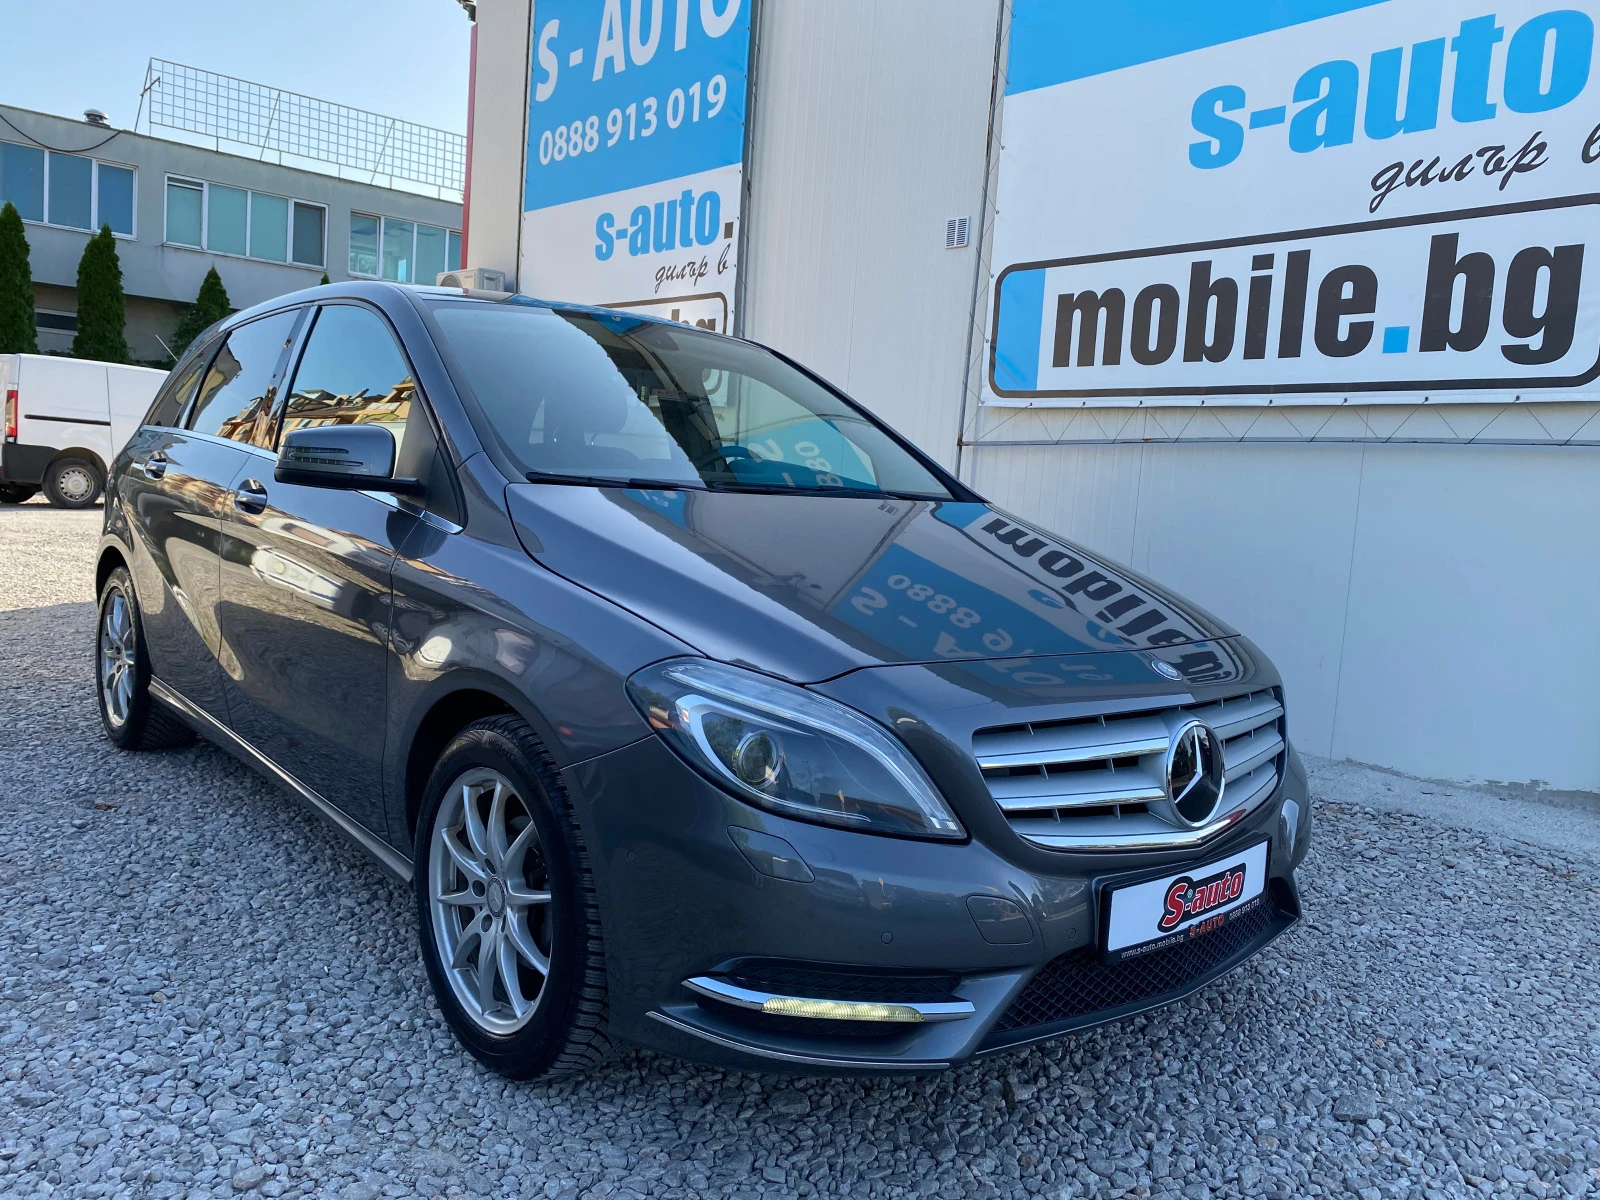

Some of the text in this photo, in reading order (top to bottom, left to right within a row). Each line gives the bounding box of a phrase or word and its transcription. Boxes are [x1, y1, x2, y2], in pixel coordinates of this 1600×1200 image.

[539, 74, 727, 166] 0888 913 019
[1188, 9, 1595, 170] s-auto
[1369, 130, 1550, 214] дилър
[654, 255, 709, 294] дилър
[1051, 232, 1586, 368] mobile.bg
[1161, 871, 1244, 928] S-auto
[1189, 914, 1225, 938] S-AUTO
